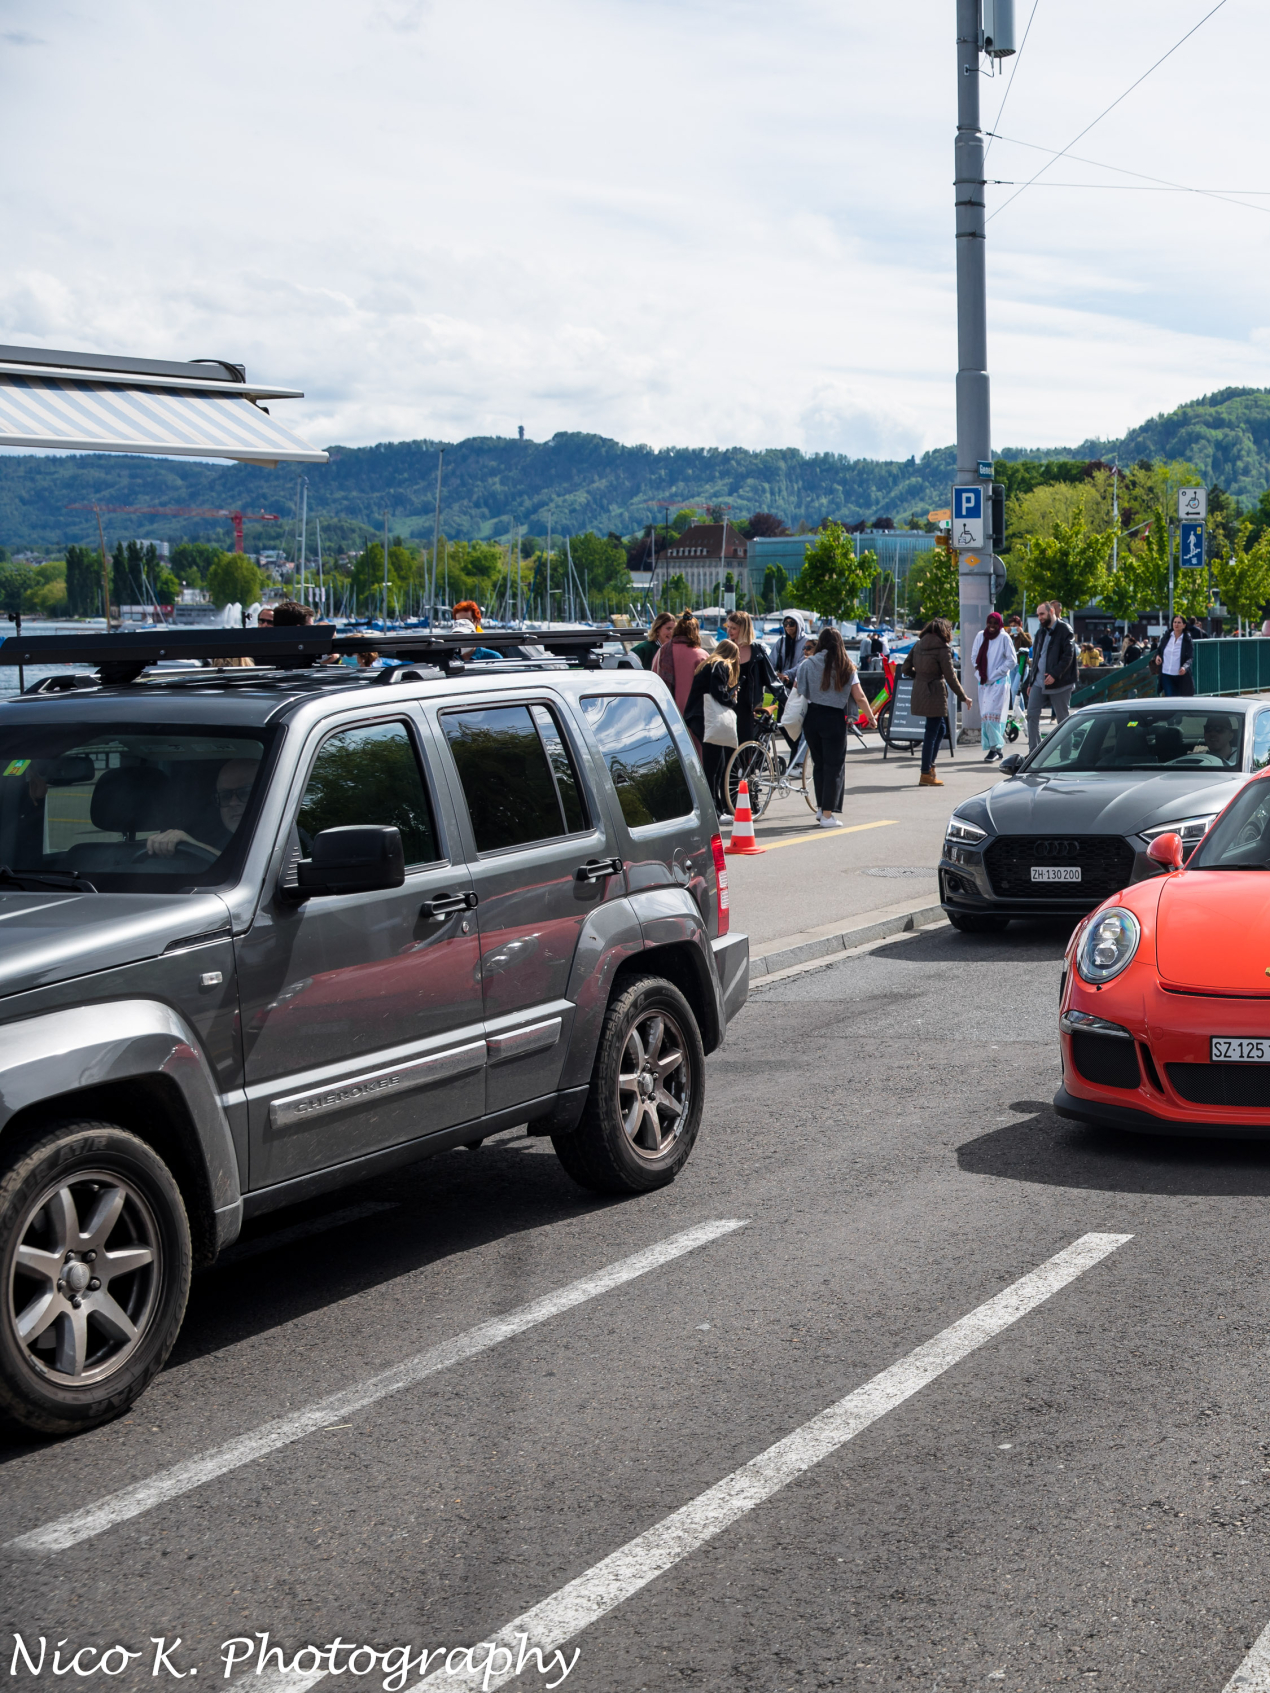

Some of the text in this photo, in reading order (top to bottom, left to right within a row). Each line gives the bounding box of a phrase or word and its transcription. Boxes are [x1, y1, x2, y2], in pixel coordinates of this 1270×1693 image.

[961, 492, 975, 516] P
[1063, 869, 1080, 880] 200
[294, 1075, 400, 1114] CHEROKEE
